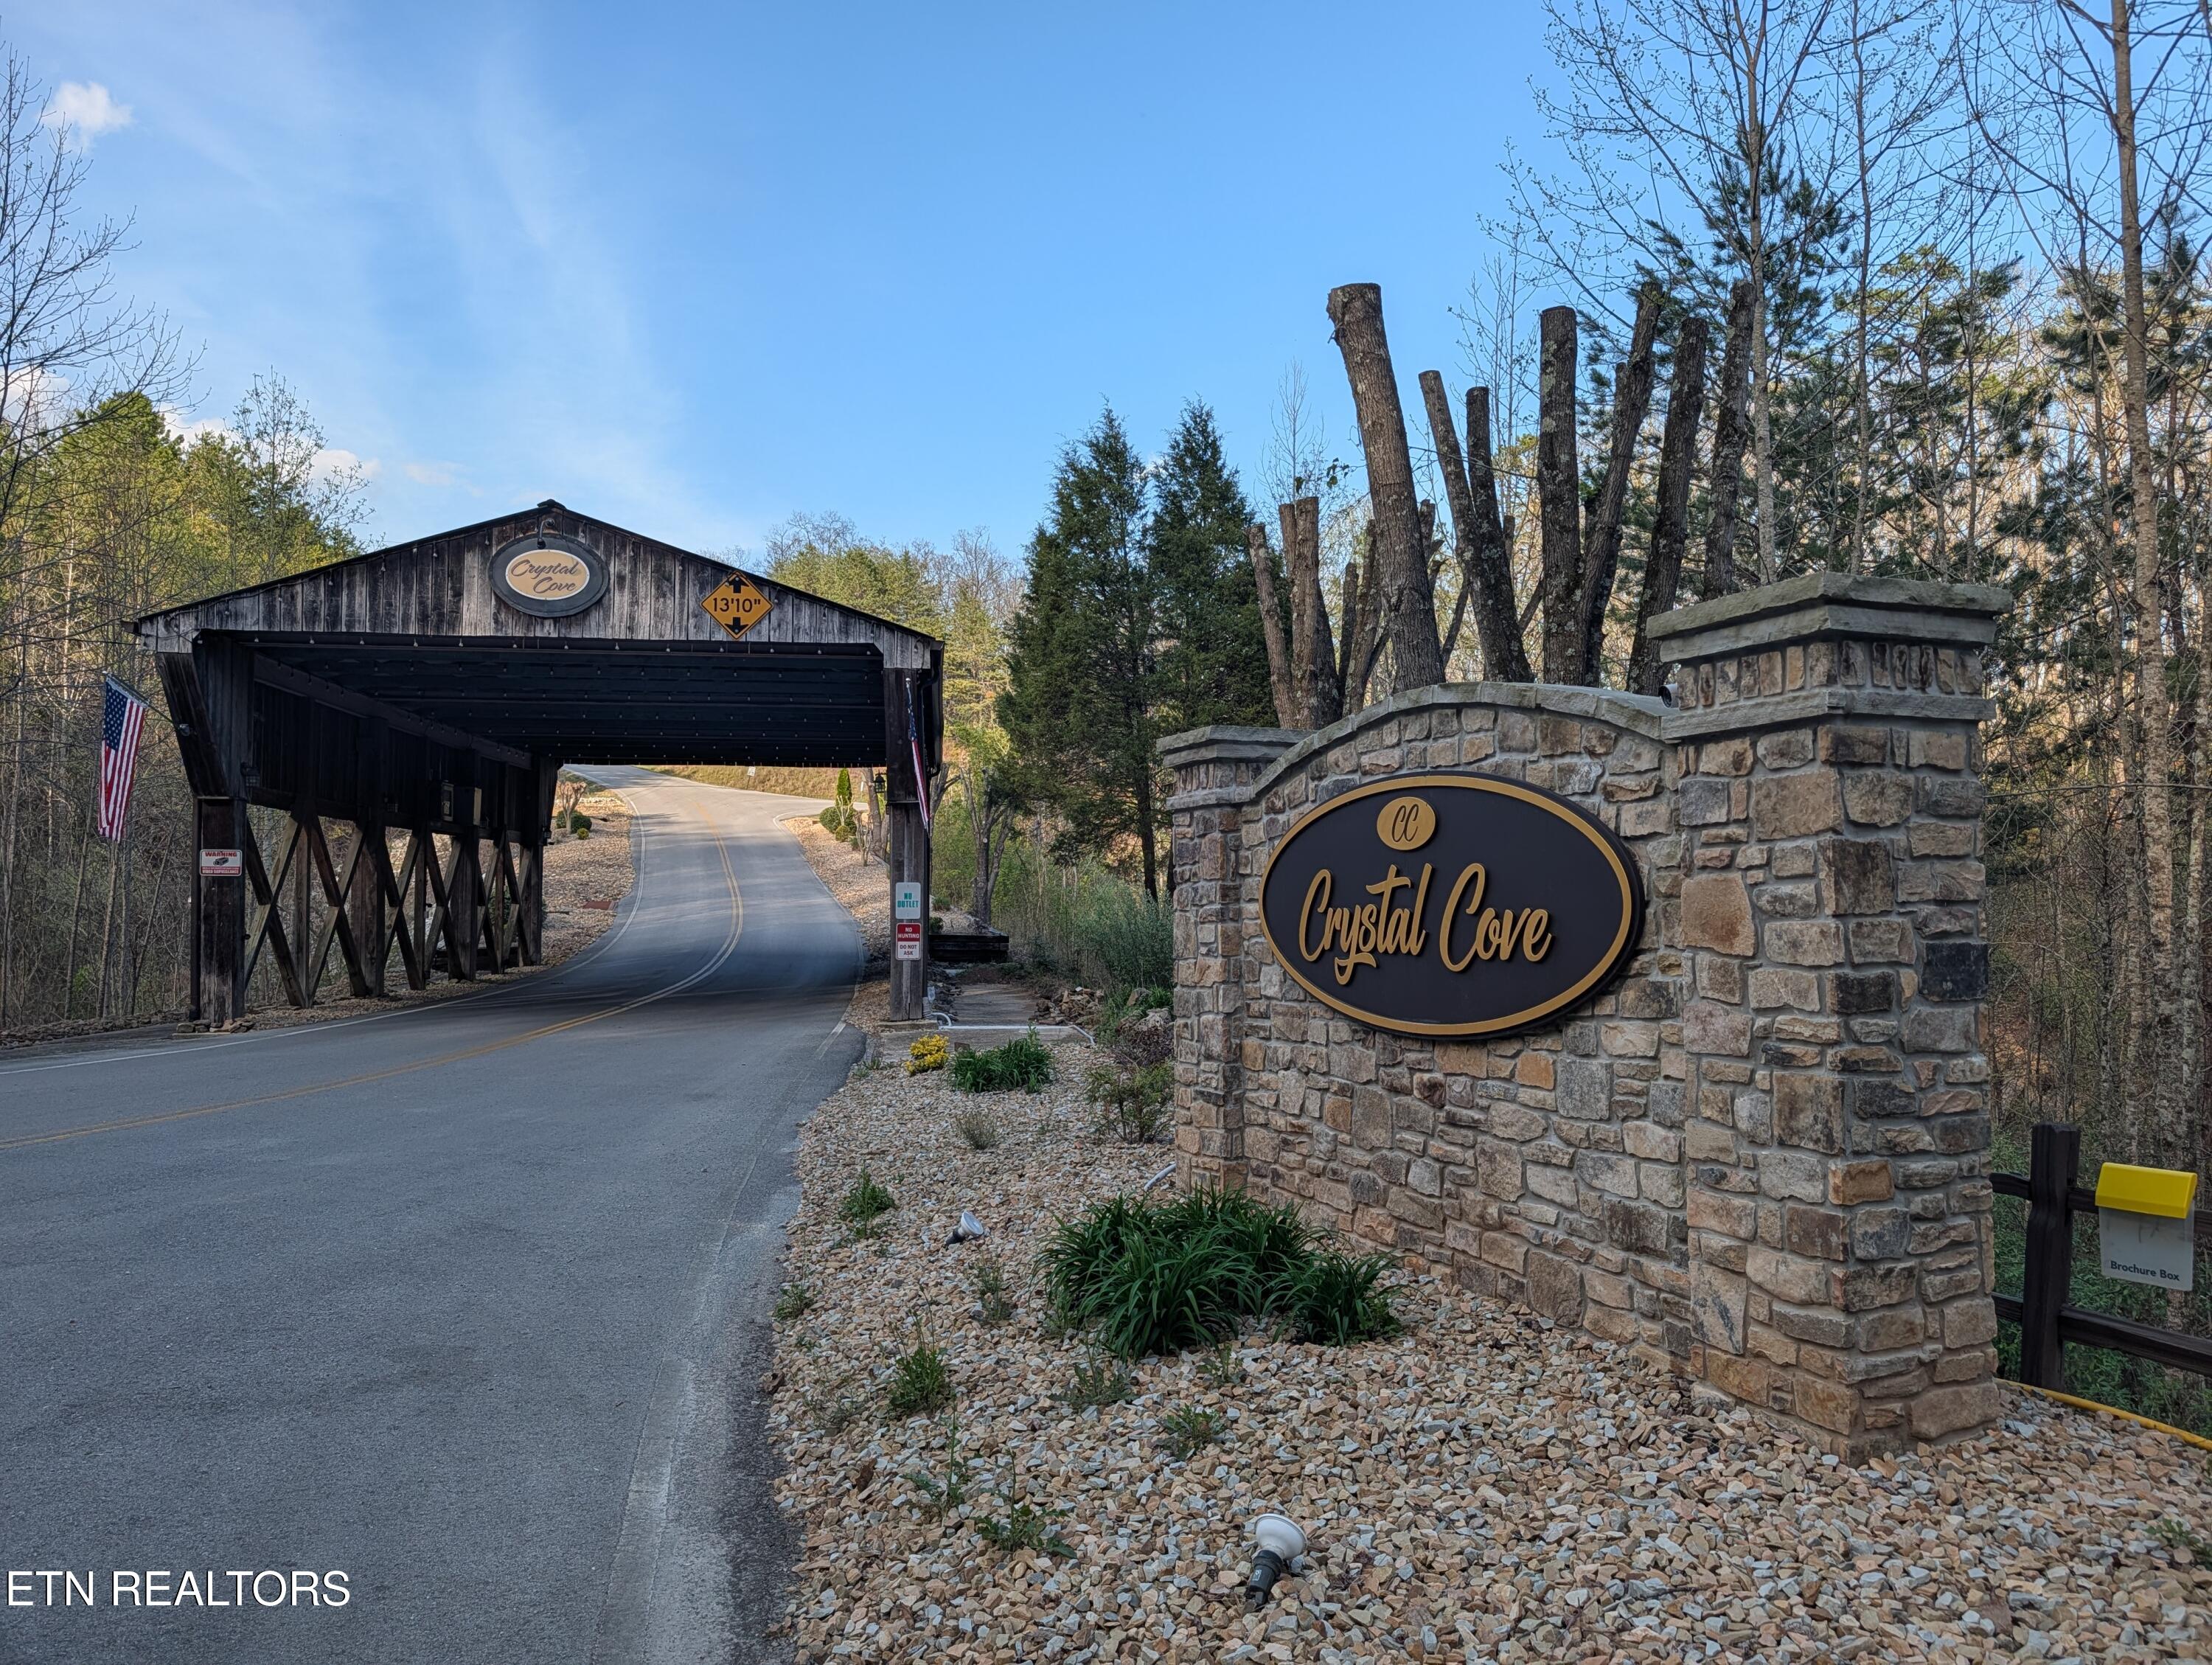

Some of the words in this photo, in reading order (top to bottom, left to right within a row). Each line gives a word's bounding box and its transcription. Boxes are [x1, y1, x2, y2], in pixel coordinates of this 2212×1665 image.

[511, 559, 579, 579] Crystal
[533, 577, 576, 593] Cove
[713, 597, 761, 613] 13'10"
[1391, 804, 1419, 842] CC
[1299, 863, 1433, 985] Crystal
[1439, 863, 1552, 973] Cove
[2110, 1260, 2157, 1276] Brochure
[2160, 1269, 2180, 1281] Box
